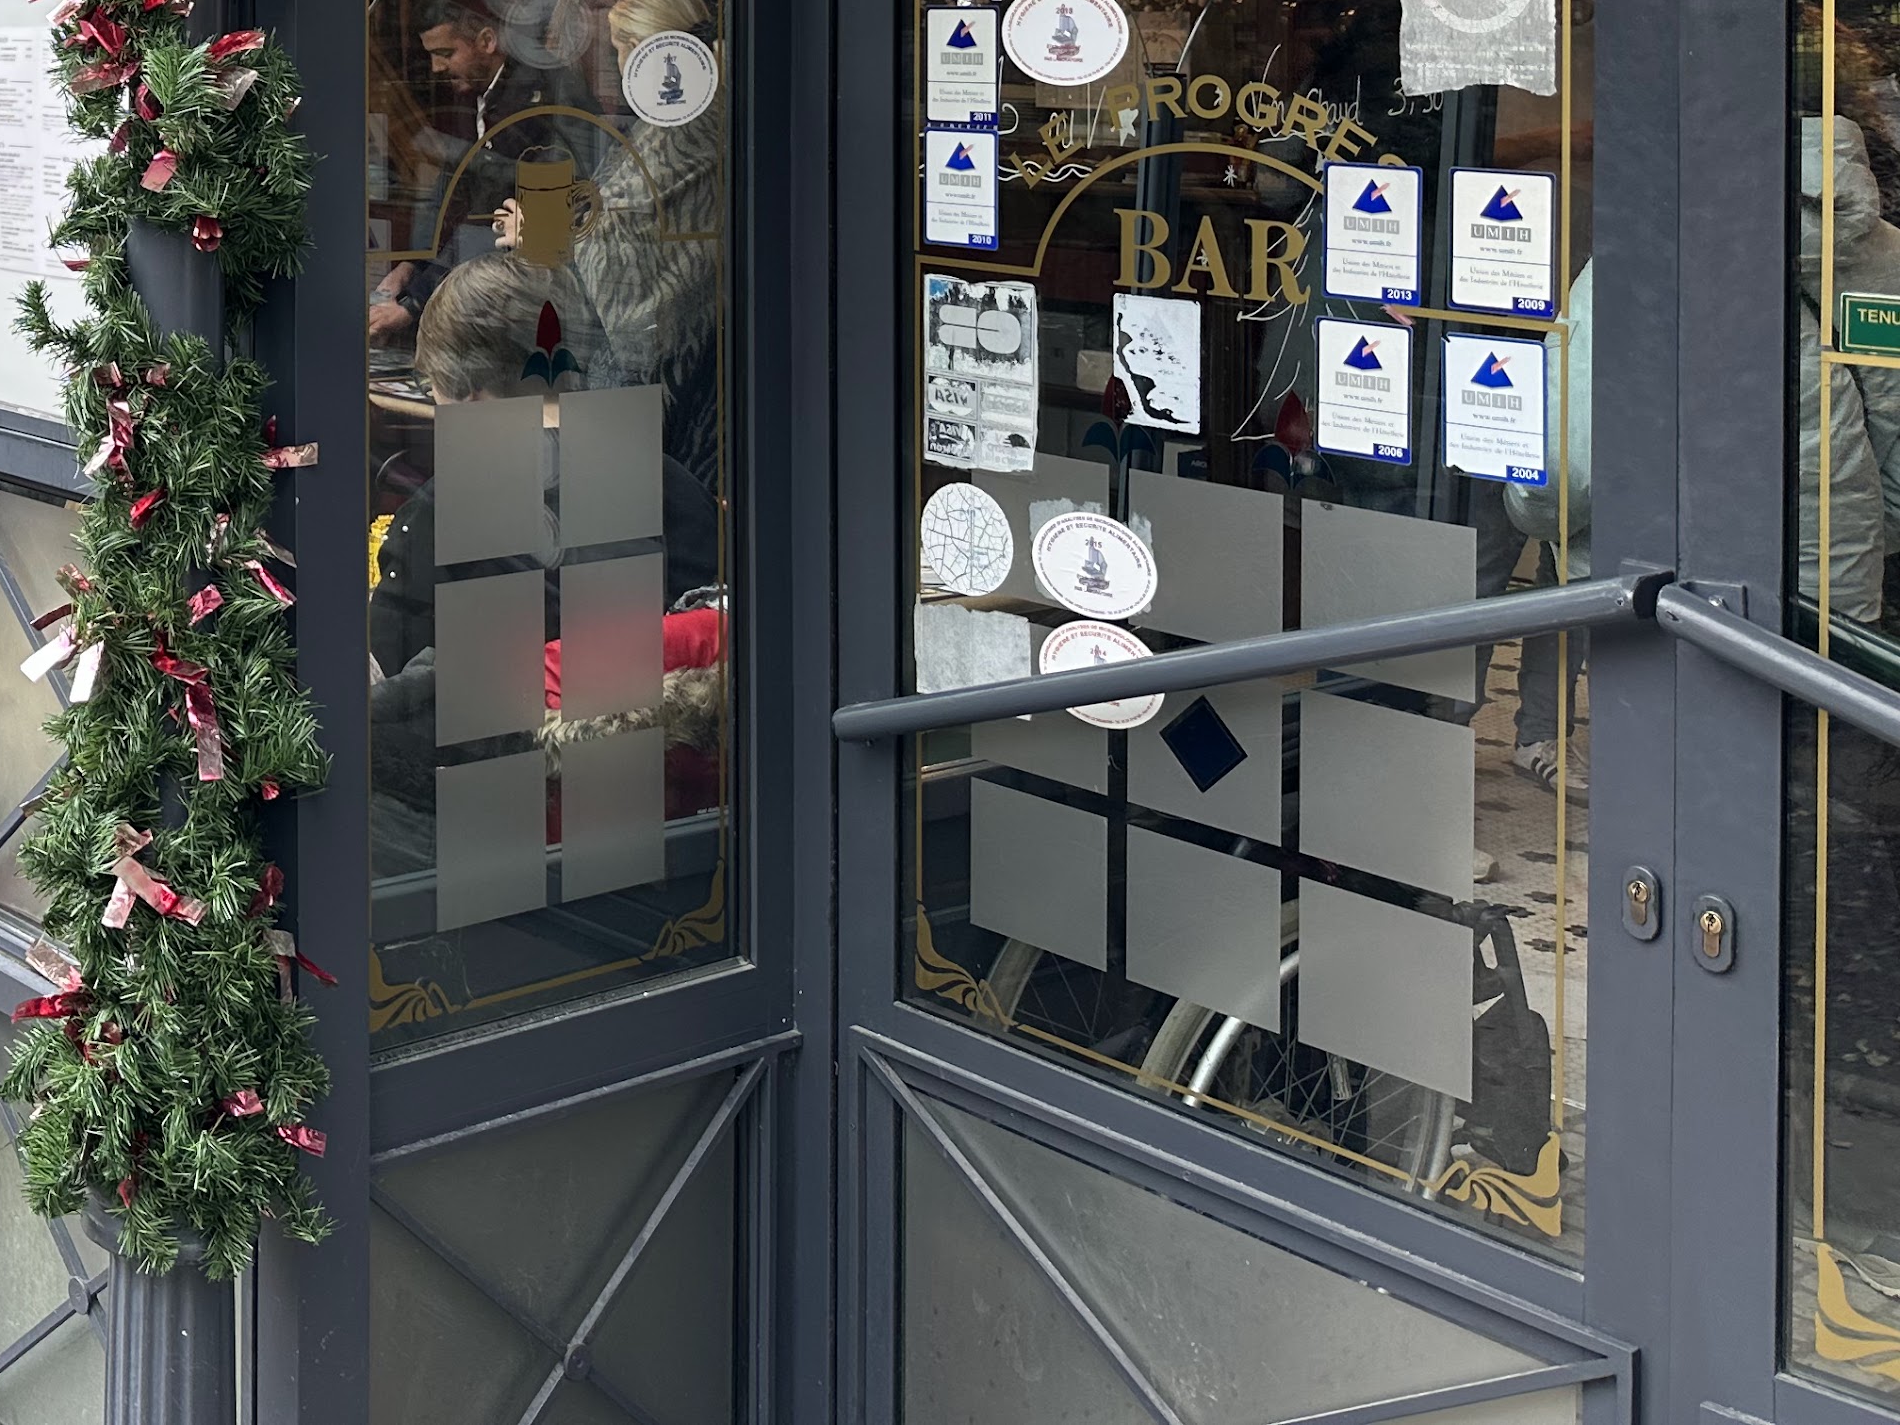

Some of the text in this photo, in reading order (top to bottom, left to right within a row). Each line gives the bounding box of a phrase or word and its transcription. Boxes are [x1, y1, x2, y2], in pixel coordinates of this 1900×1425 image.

[973, 113, 992, 121] 2011
[1009, 110, 1086, 190] LE
[1105, 74, 1408, 167] PROGRE
[1343, 216, 1400, 235] UMIH
[1471, 224, 1531, 242] UMIH
[972, 235, 992, 244] 2010
[1113, 208, 1311, 305] BAR
[1387, 288, 1412, 301] 2013
[1517, 298, 1546, 311] 2009
[1335, 371, 1391, 392] UMIH
[1461, 389, 1522, 411] UMIH
[1378, 445, 1404, 458] 2006
[1512, 467, 1539, 480] 2004
